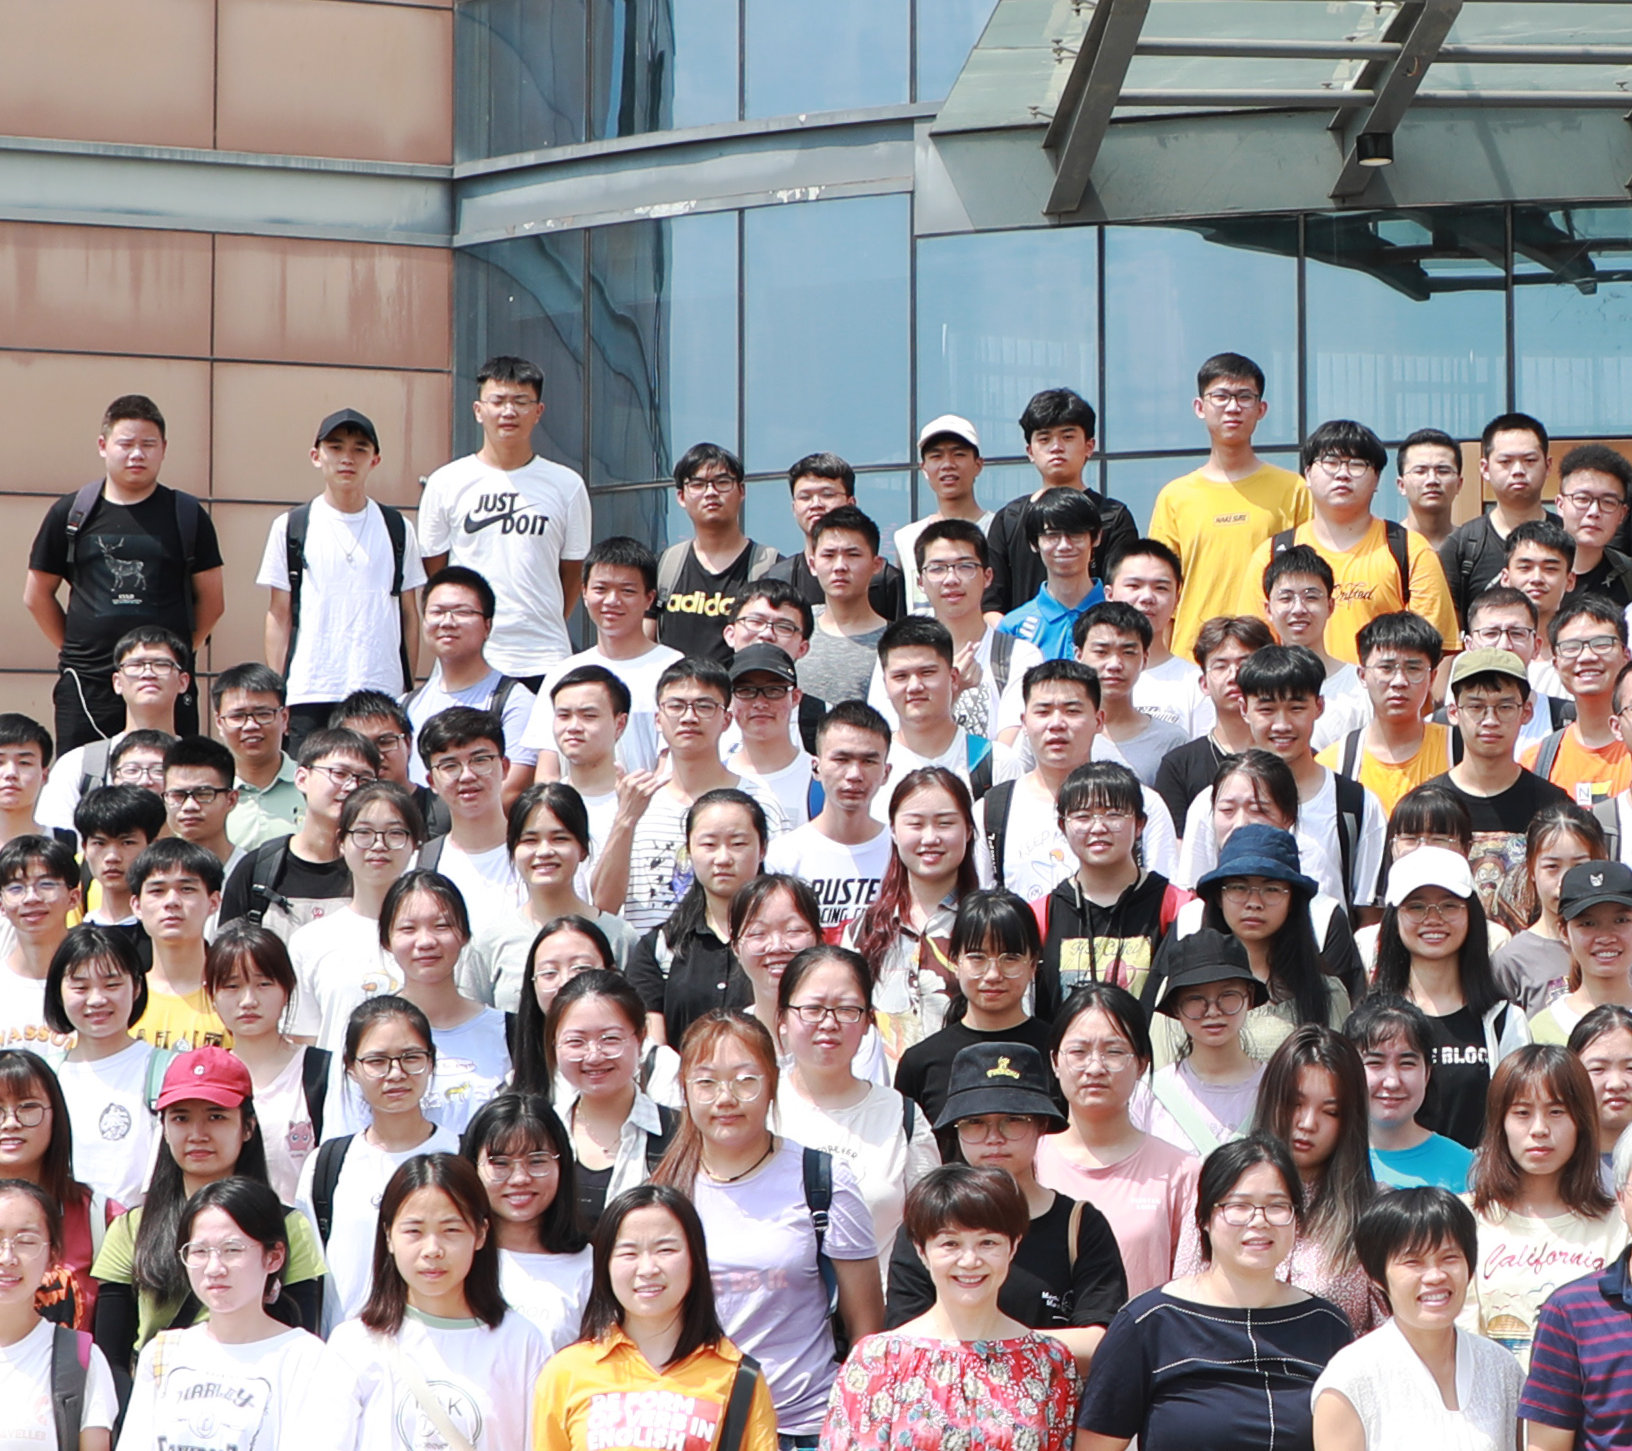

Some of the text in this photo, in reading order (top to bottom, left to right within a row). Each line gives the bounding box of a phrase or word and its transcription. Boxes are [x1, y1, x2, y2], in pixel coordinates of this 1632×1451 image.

[474, 492, 520, 515] JUST
[1484, 1242, 1607, 1281] California
[624, 1391, 696, 1415] FORM
[625, 1409, 689, 1433] VERB
[690, 1417, 716, 1443] IN
